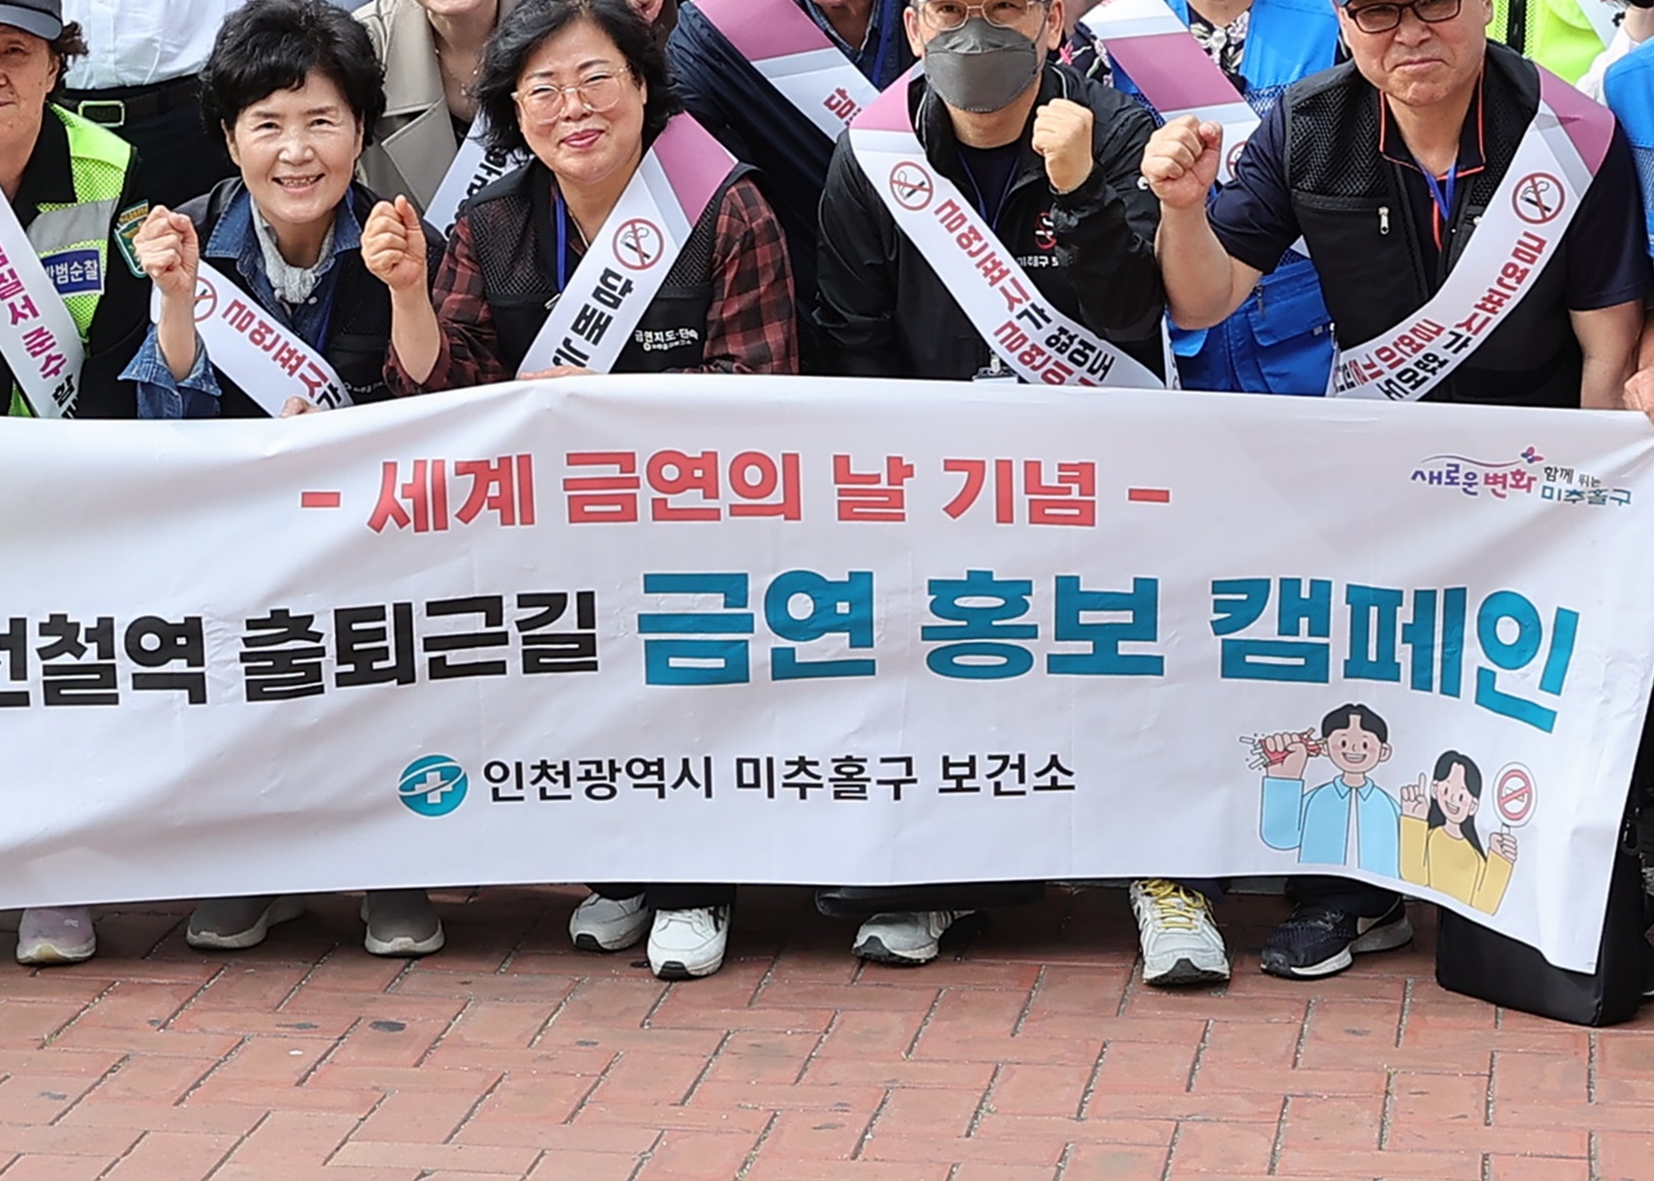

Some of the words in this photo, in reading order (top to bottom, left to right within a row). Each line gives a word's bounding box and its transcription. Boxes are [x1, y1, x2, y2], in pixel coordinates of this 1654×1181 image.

[932, 199, 1052, 330] 금연표시가
[1044, 323, 1116, 383] 없어도
[1440, 232, 1548, 356] 금연표시가
[21, 323, 70, 382] 준수
[1374, 318, 1447, 373] 금연이
[1381, 355, 1451, 401] 없어도
[369, 454, 534, 532] 세계
[564, 450, 801, 523] 금연의
[834, 455, 914, 521] 날
[945, 460, 1095, 526] 기념
[1410, 463, 1479, 496] 새로운
[1483, 468, 1538, 500] 변화
[1541, 484, 1632, 506] 미추홀구
[1544, 465, 1575, 485] 함께
[1578, 473, 1601, 488] 뛰는
[240, 591, 598, 701] 출퇴근길
[639, 571, 875, 685] 금연
[923, 570, 1163, 679] 홍보
[1212, 578, 1579, 733] 캠페인
[484, 756, 712, 802] 인천광역시
[736, 755, 918, 801] 미추홀구
[938, 753, 1076, 797] 보건소
